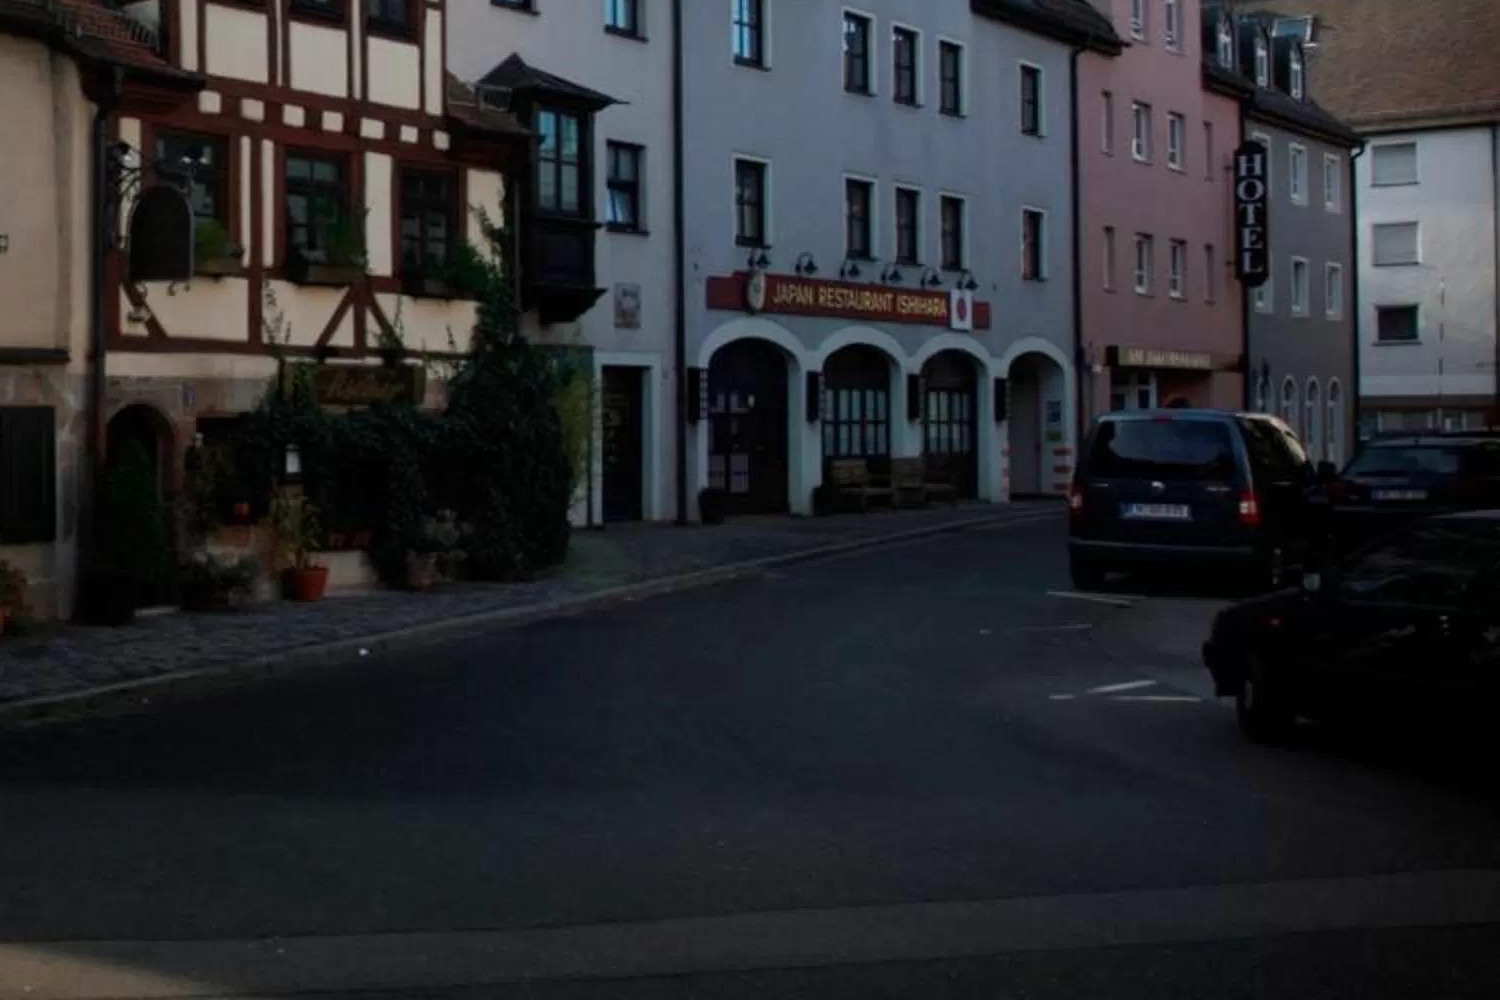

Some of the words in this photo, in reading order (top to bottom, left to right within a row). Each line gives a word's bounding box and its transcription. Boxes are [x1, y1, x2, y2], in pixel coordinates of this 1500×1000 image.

[1237, 153, 1265, 273] HOTEL
[772, 282, 813, 305] JAPAN
[818, 287, 894, 313] RESTAURANT
[896, 294, 949, 318] ISHIHARA
